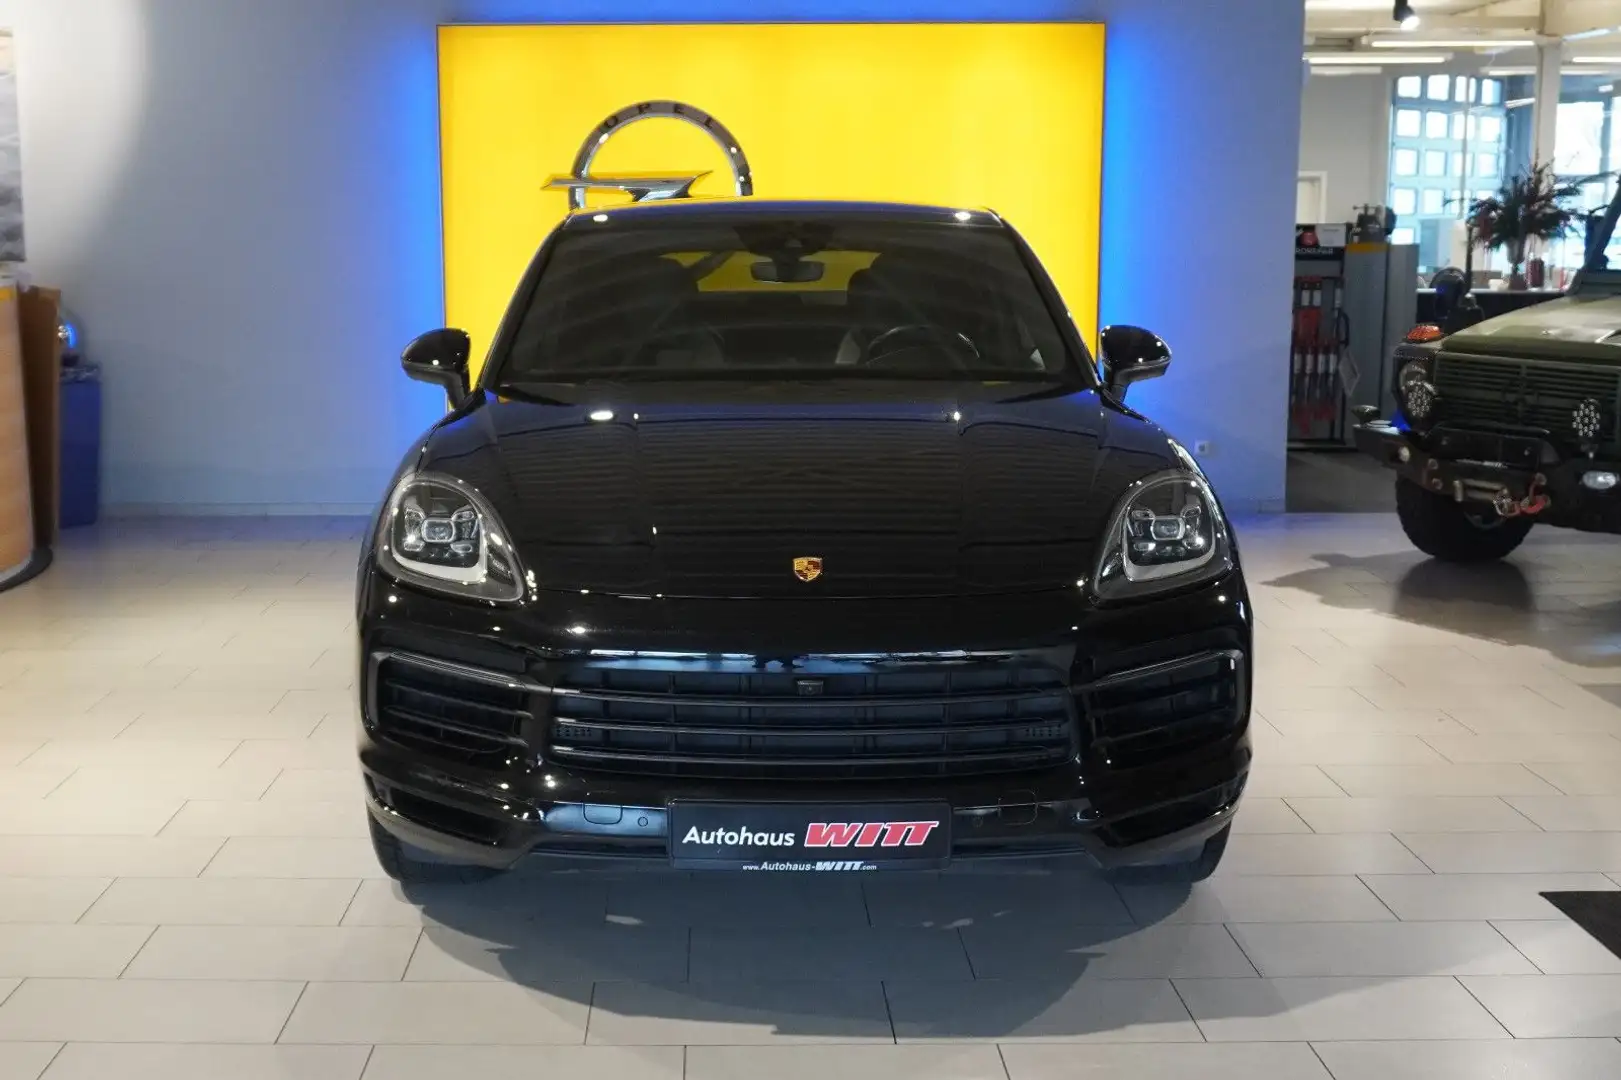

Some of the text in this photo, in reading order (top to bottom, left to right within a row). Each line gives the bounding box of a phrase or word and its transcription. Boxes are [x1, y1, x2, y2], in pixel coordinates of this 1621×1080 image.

[602, 102, 715, 129] OPEL
[682, 820, 940, 848] Autohaus WITT
[742, 860, 877, 871] www.Autohaus-WITT.com
